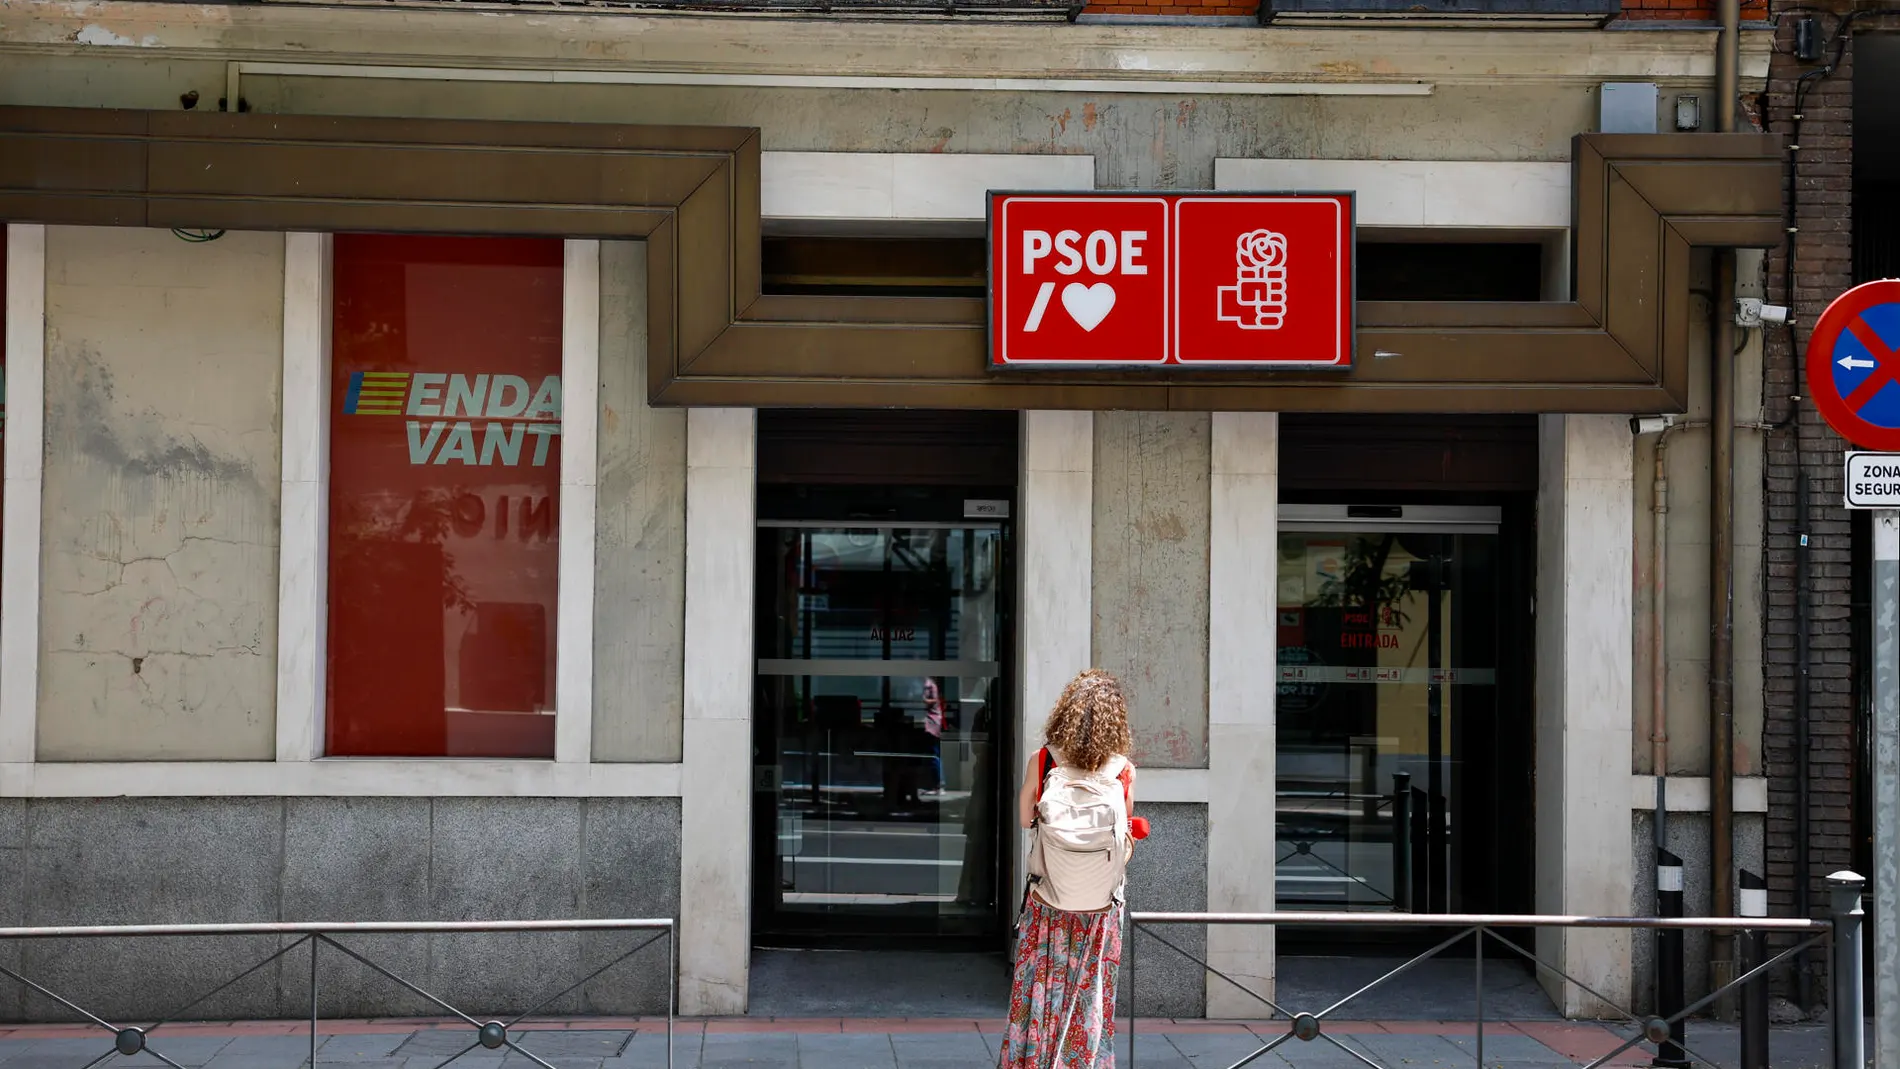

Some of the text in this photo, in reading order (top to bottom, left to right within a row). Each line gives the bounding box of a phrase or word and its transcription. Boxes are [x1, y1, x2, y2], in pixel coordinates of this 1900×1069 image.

[1023, 229, 1148, 275] PSOE
[406, 372, 562, 419] ENDA
[406, 420, 562, 467] VANT
[1863, 465, 1900, 478] ZONA
[1855, 482, 1900, 496] SEGUR
[1340, 632, 1399, 648] ENTRADA
